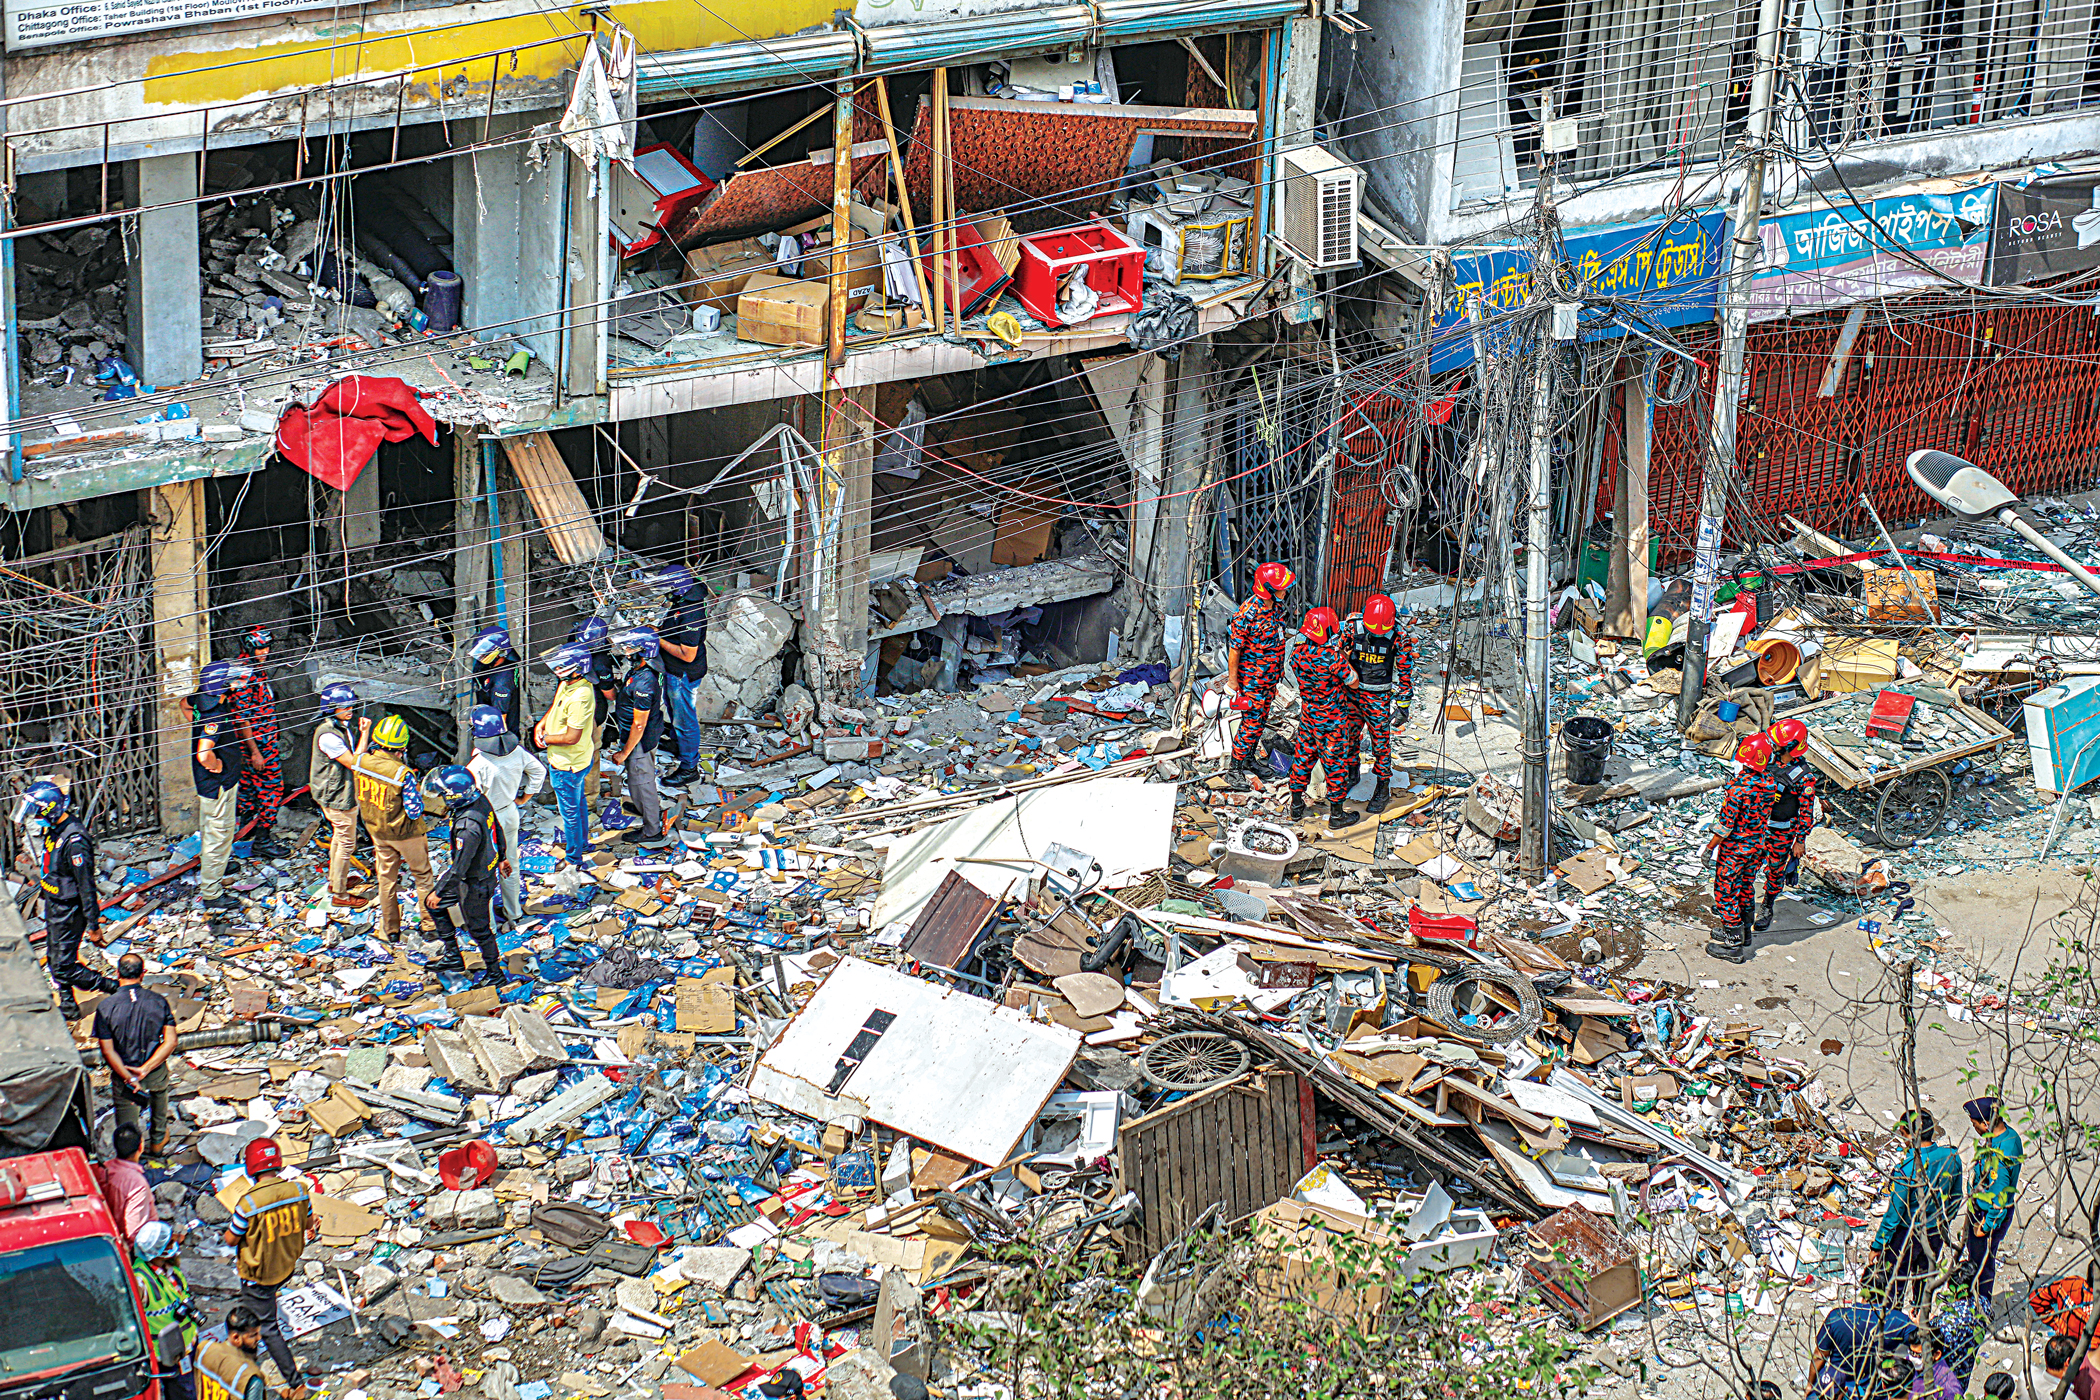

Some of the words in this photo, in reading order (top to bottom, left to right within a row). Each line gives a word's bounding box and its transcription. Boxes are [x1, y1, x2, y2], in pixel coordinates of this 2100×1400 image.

[18, 10, 57, 22] Dhaka
[60, 4, 101, 16] Office:
[18, 20, 69, 32] Chittagong
[72, 15, 102, 25] Office:
[129, 7, 165, 17] Building
[166, 5, 183, 13] (1st
[185, 1, 210, 10] Floor)
[18, 30, 66, 40] Benapole
[69, 25, 102, 34] Office:
[105, 14, 181, 29] Powrashava
[185, 7, 232, 18] Bhaban
[235, 4, 260, 13] (1st
[1793, 212, 1870, 260] আজিজ
[2010, 210, 2062, 238] ROSA
[2038, 232, 2062, 241] BEAUTY
[853, 287, 872, 296] AZAD
[1359, 652, 1385, 664] FIRE
[357, 774, 388, 811] PBI
[264, 1204, 301, 1243] PBI
[285, 1294, 328, 1322] RAK
